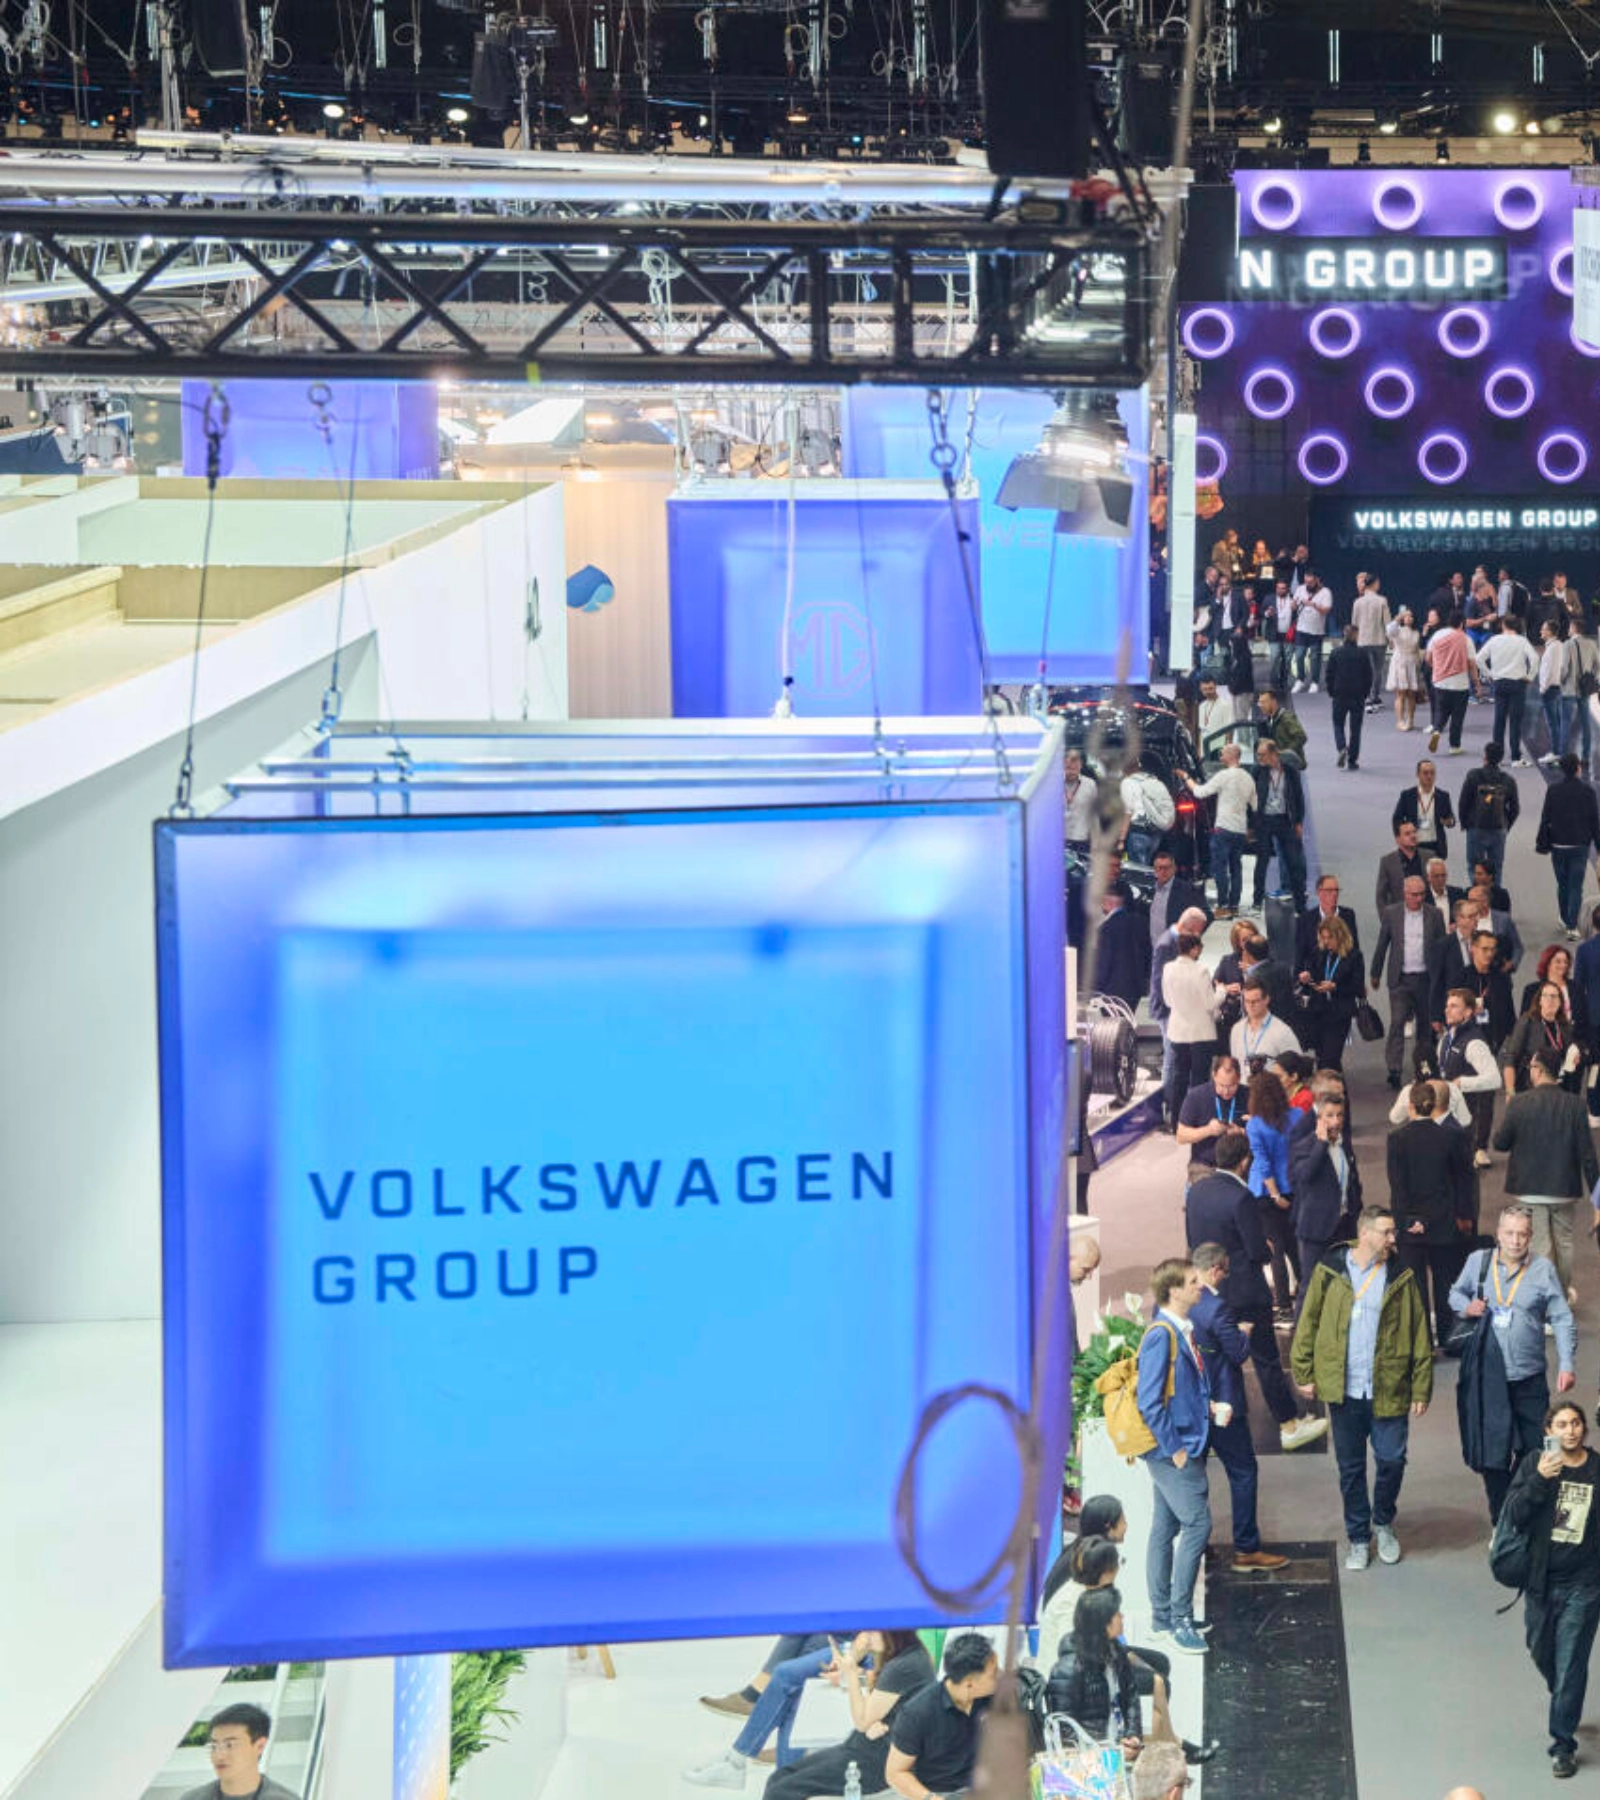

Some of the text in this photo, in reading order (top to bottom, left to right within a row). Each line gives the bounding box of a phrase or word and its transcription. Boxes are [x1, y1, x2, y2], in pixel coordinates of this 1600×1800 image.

[1305, 249, 1494, 289] GROUP
[1355, 508, 1599, 529] VOLKSWAGEN GROUP
[307, 1151, 893, 1220] VOLKSWAGEN
[312, 1246, 598, 1304] GROUP
